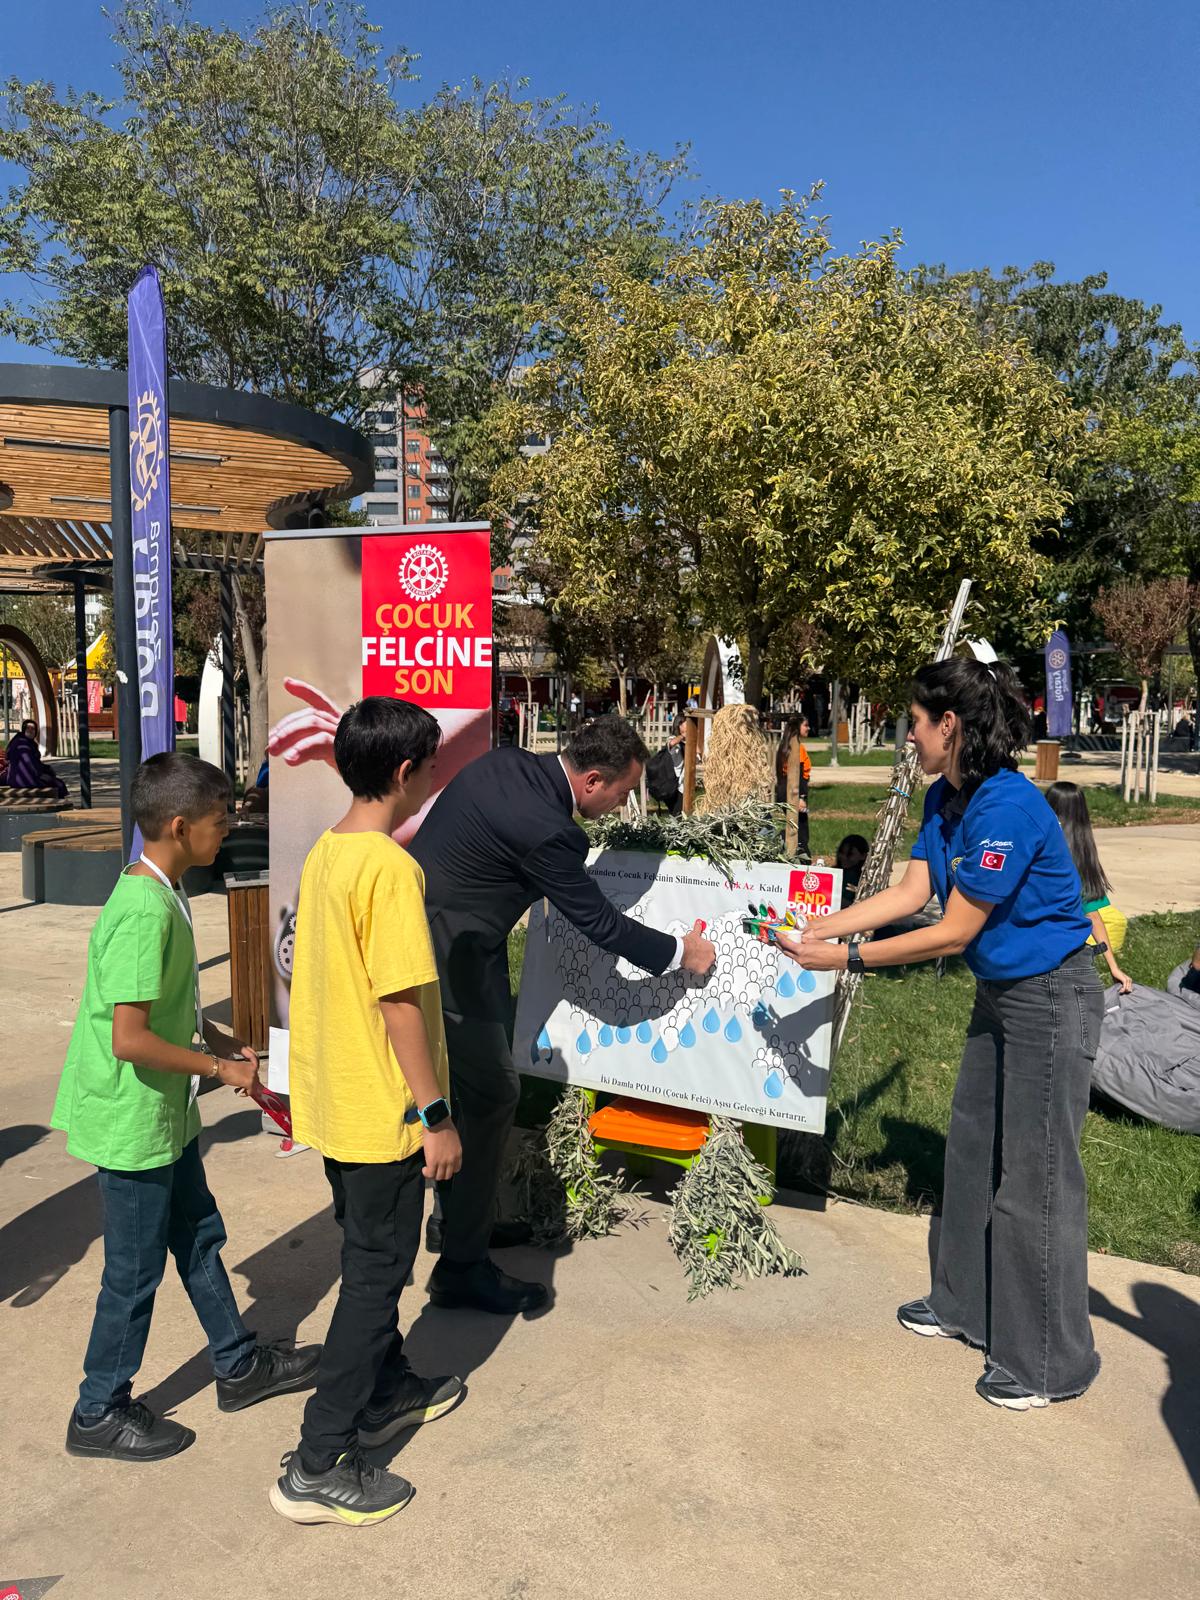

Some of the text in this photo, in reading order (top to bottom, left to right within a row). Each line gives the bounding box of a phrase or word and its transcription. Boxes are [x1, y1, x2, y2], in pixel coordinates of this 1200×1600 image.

[375, 603, 475, 636] ÇOCUK
[362, 629, 492, 667] FELCİNE
[395, 669, 453, 695] SON
[586, 867, 616, 878] üzünden
[617, 870, 642, 880] Çocuk
[643, 872, 674, 883] Felcinin
[675, 875, 720, 888] Silinmesine
[744, 882, 755, 890] Az
[759, 883, 783, 893] Kaldı
[787, 901, 832, 917] POLIO
[794, 891, 827, 906] END
[612, 1078, 634, 1089] Damla
[635, 1083, 661, 1094] POLIO
[663, 1088, 689, 1100] (Çocuk
[691, 1093, 712, 1105] Felci)
[713, 1099, 731, 1109] Aşısı
[733, 1102, 767, 1116] Geleceği
[769, 1108, 807, 1123] Kurtarır.
